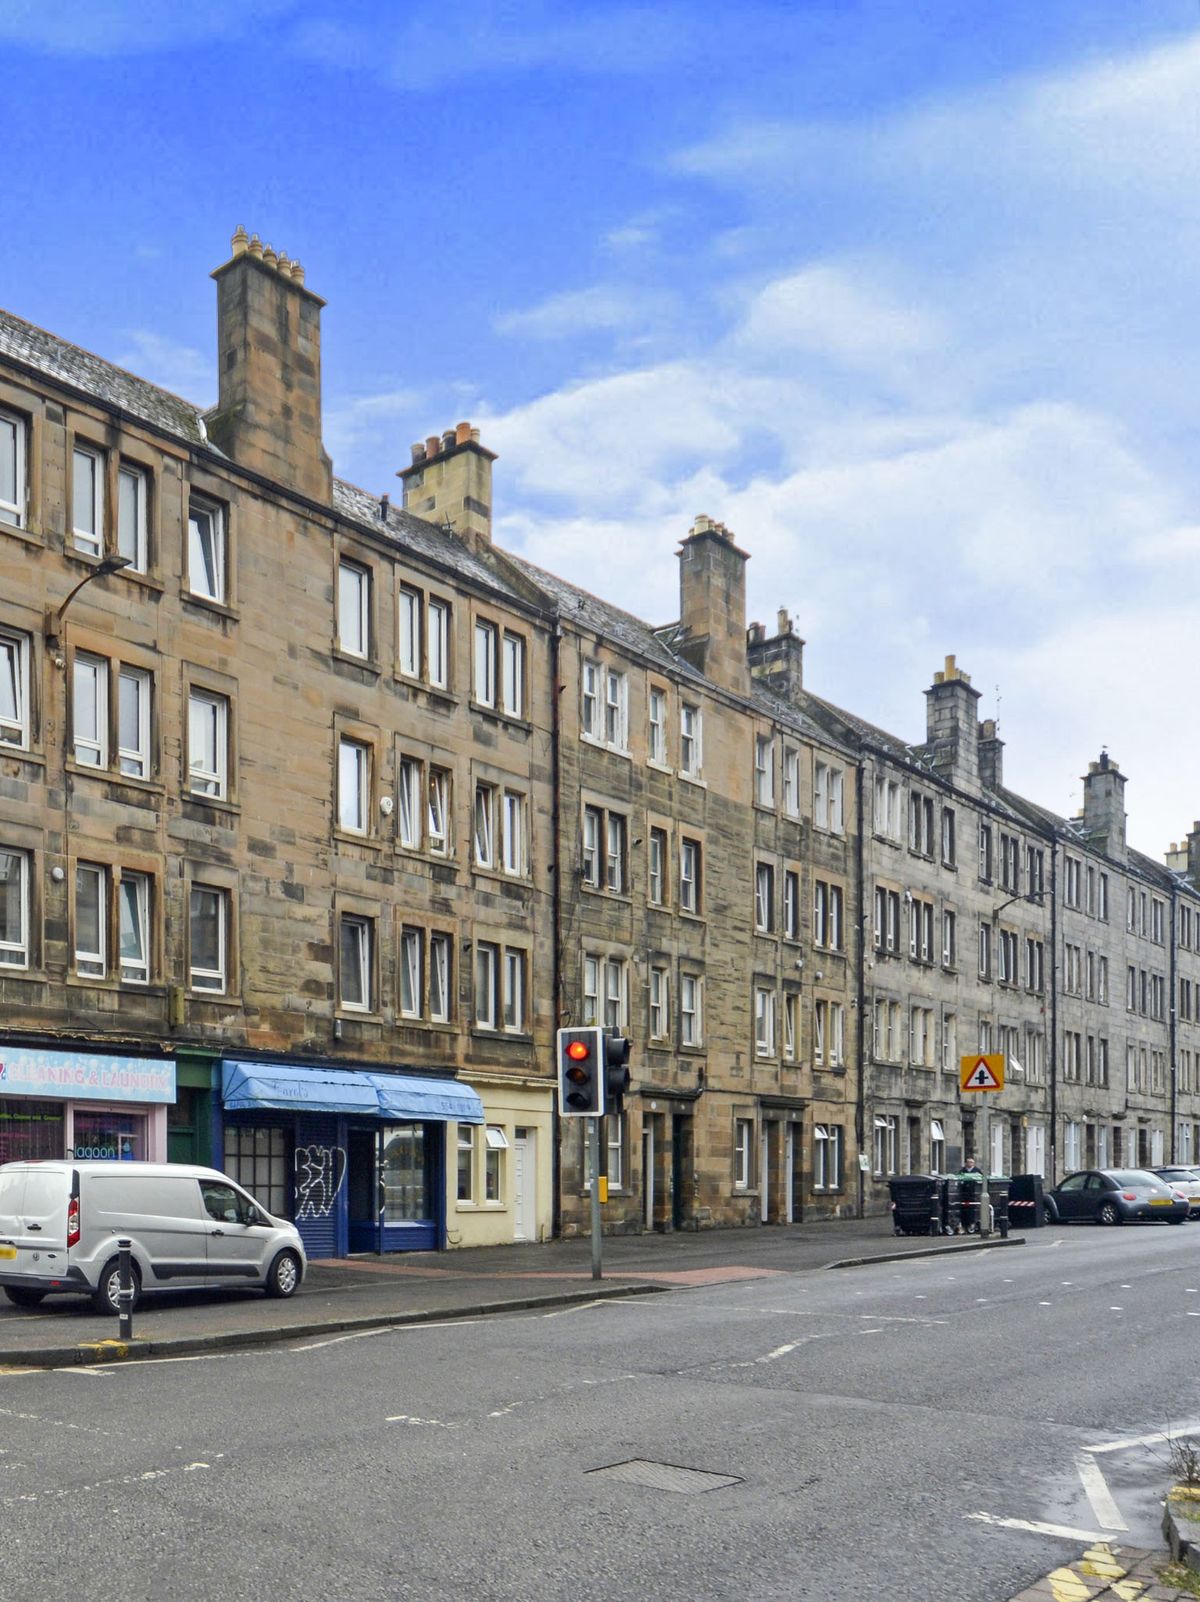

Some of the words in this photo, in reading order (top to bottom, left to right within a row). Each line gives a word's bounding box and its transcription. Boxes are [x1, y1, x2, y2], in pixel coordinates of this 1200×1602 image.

[9, 1064, 85, 1085] CLEANING
[89, 1070, 98, 1085] &
[102, 1070, 168, 1090] LAUNDRY
[74, 1143, 115, 1160] lagoon
